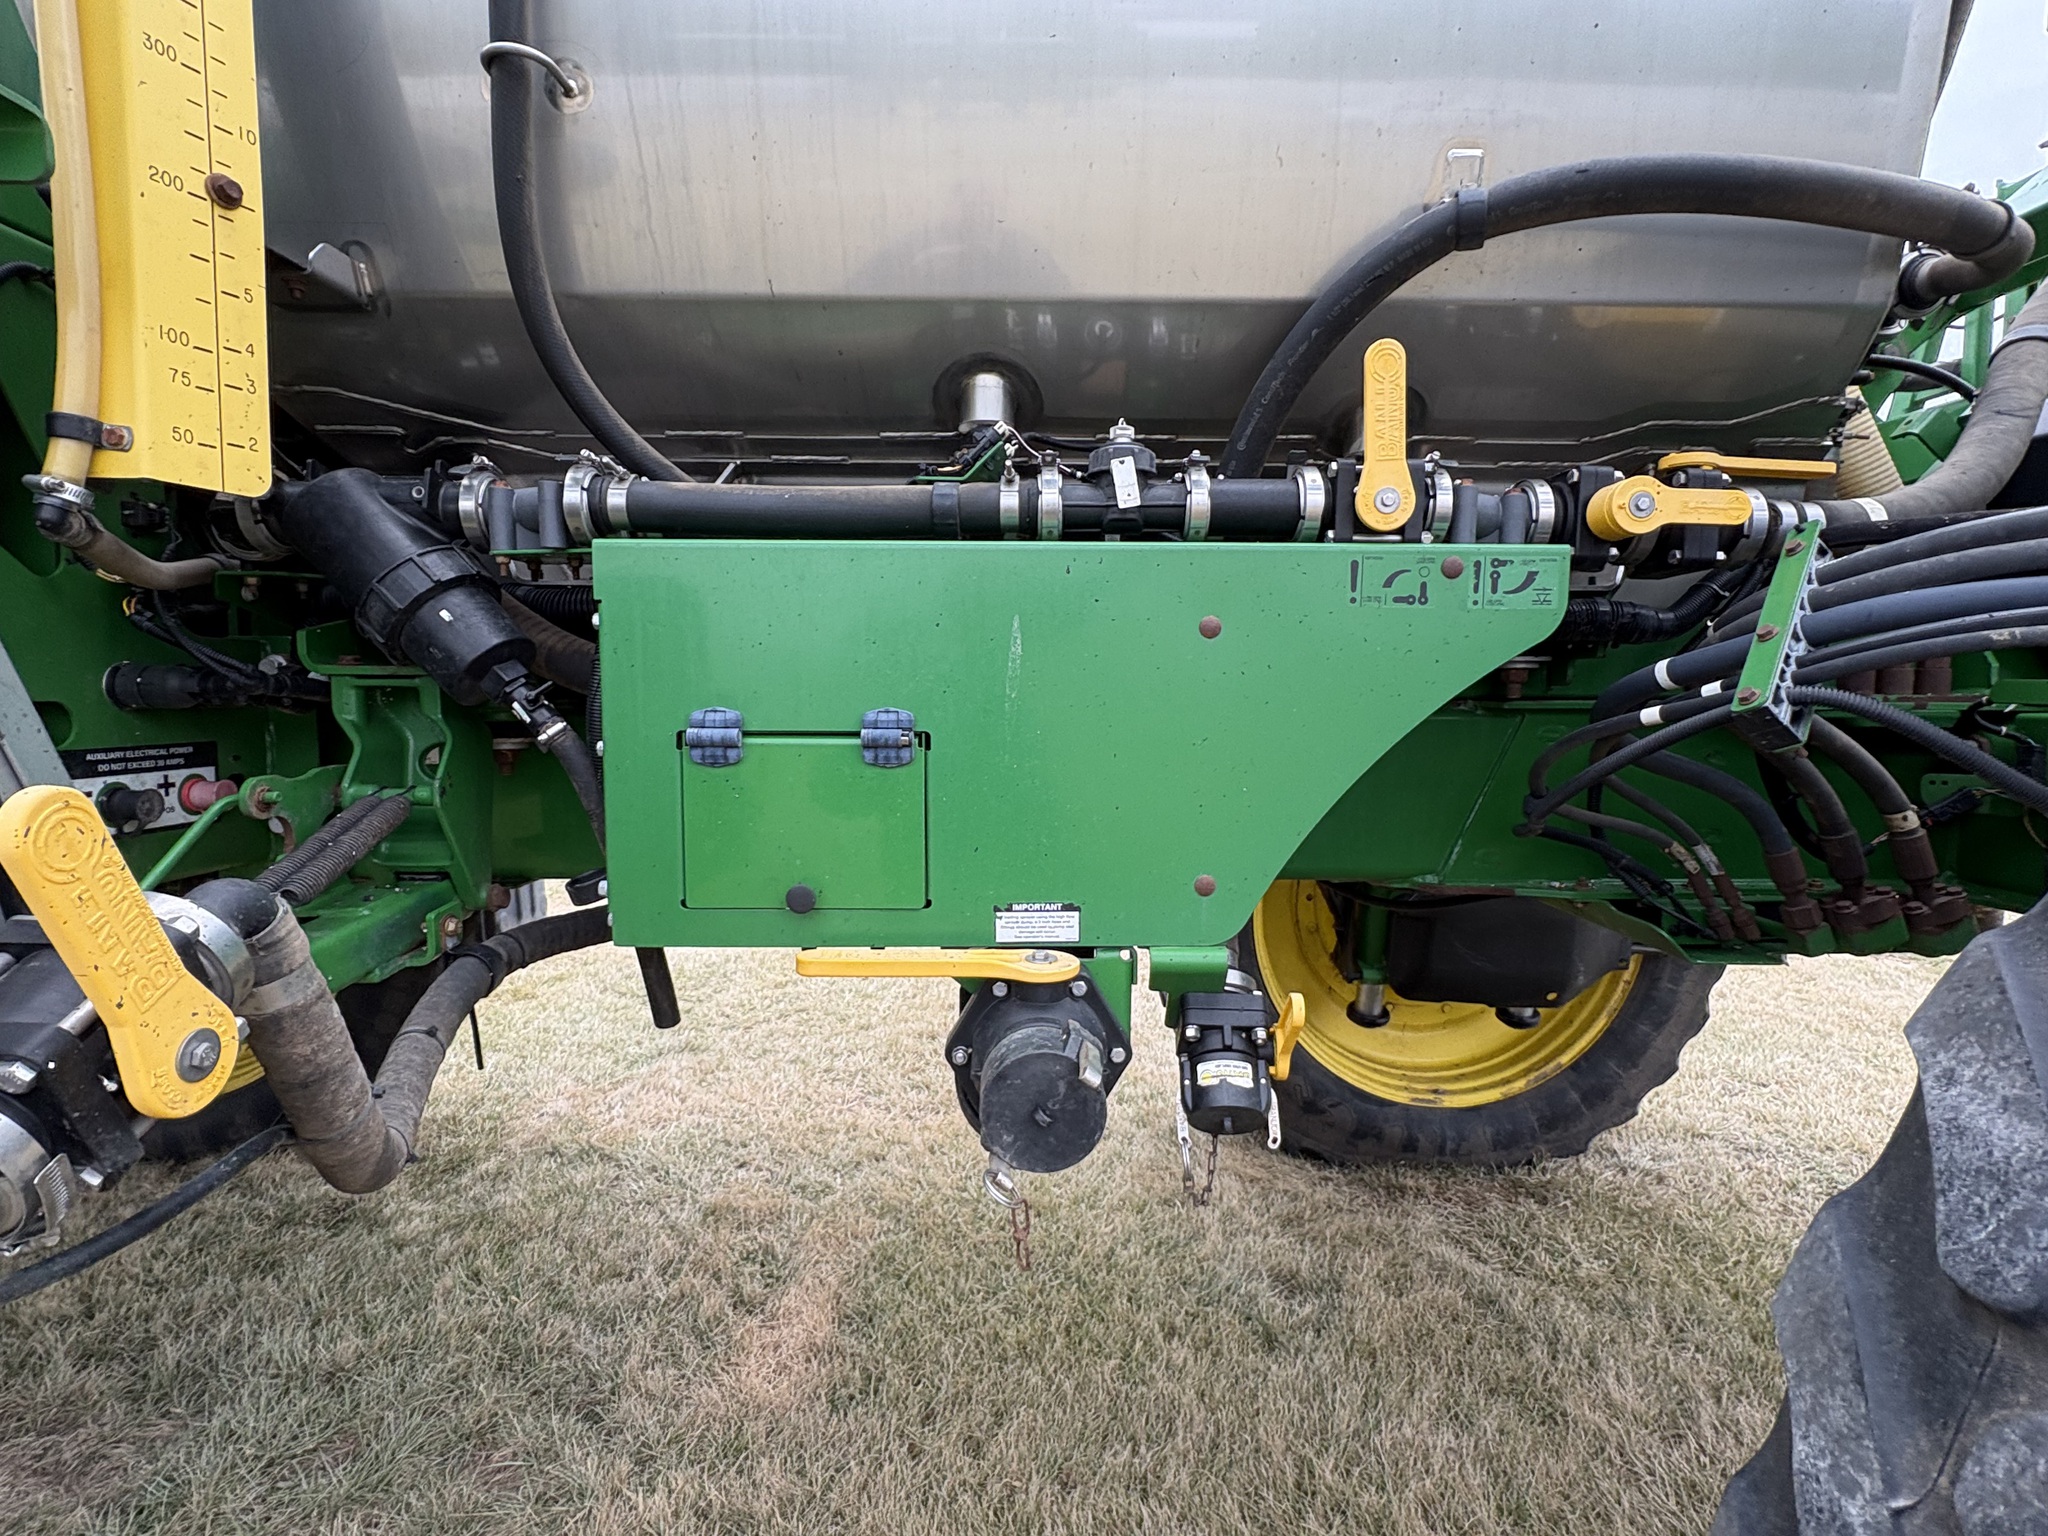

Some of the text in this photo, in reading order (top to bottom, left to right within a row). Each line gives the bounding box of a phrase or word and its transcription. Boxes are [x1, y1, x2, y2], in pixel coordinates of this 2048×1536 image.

[142, 31, 177, 62] 300
[239, 125, 257, 146] 10
[148, 164, 184, 192] 200
[243, 288, 254, 304] 5
[159, 324, 190, 347] 100
[245, 343, 255, 358] 4
[168, 367, 191, 387] 75
[246, 378, 257, 395] 3
[171, 426, 194, 445] 50
[248, 437, 259, 453] 2
[85, 746, 194, 761] AUXILIARY ELECTRICAL POWER
[97, 764, 110, 772] DO
[111, 762, 127, 771] NOT
[127, 760, 156, 769] EXCEED
[165, 757, 186, 766] AMPS
[1012, 903, 1063, 911] IMPORTANT
